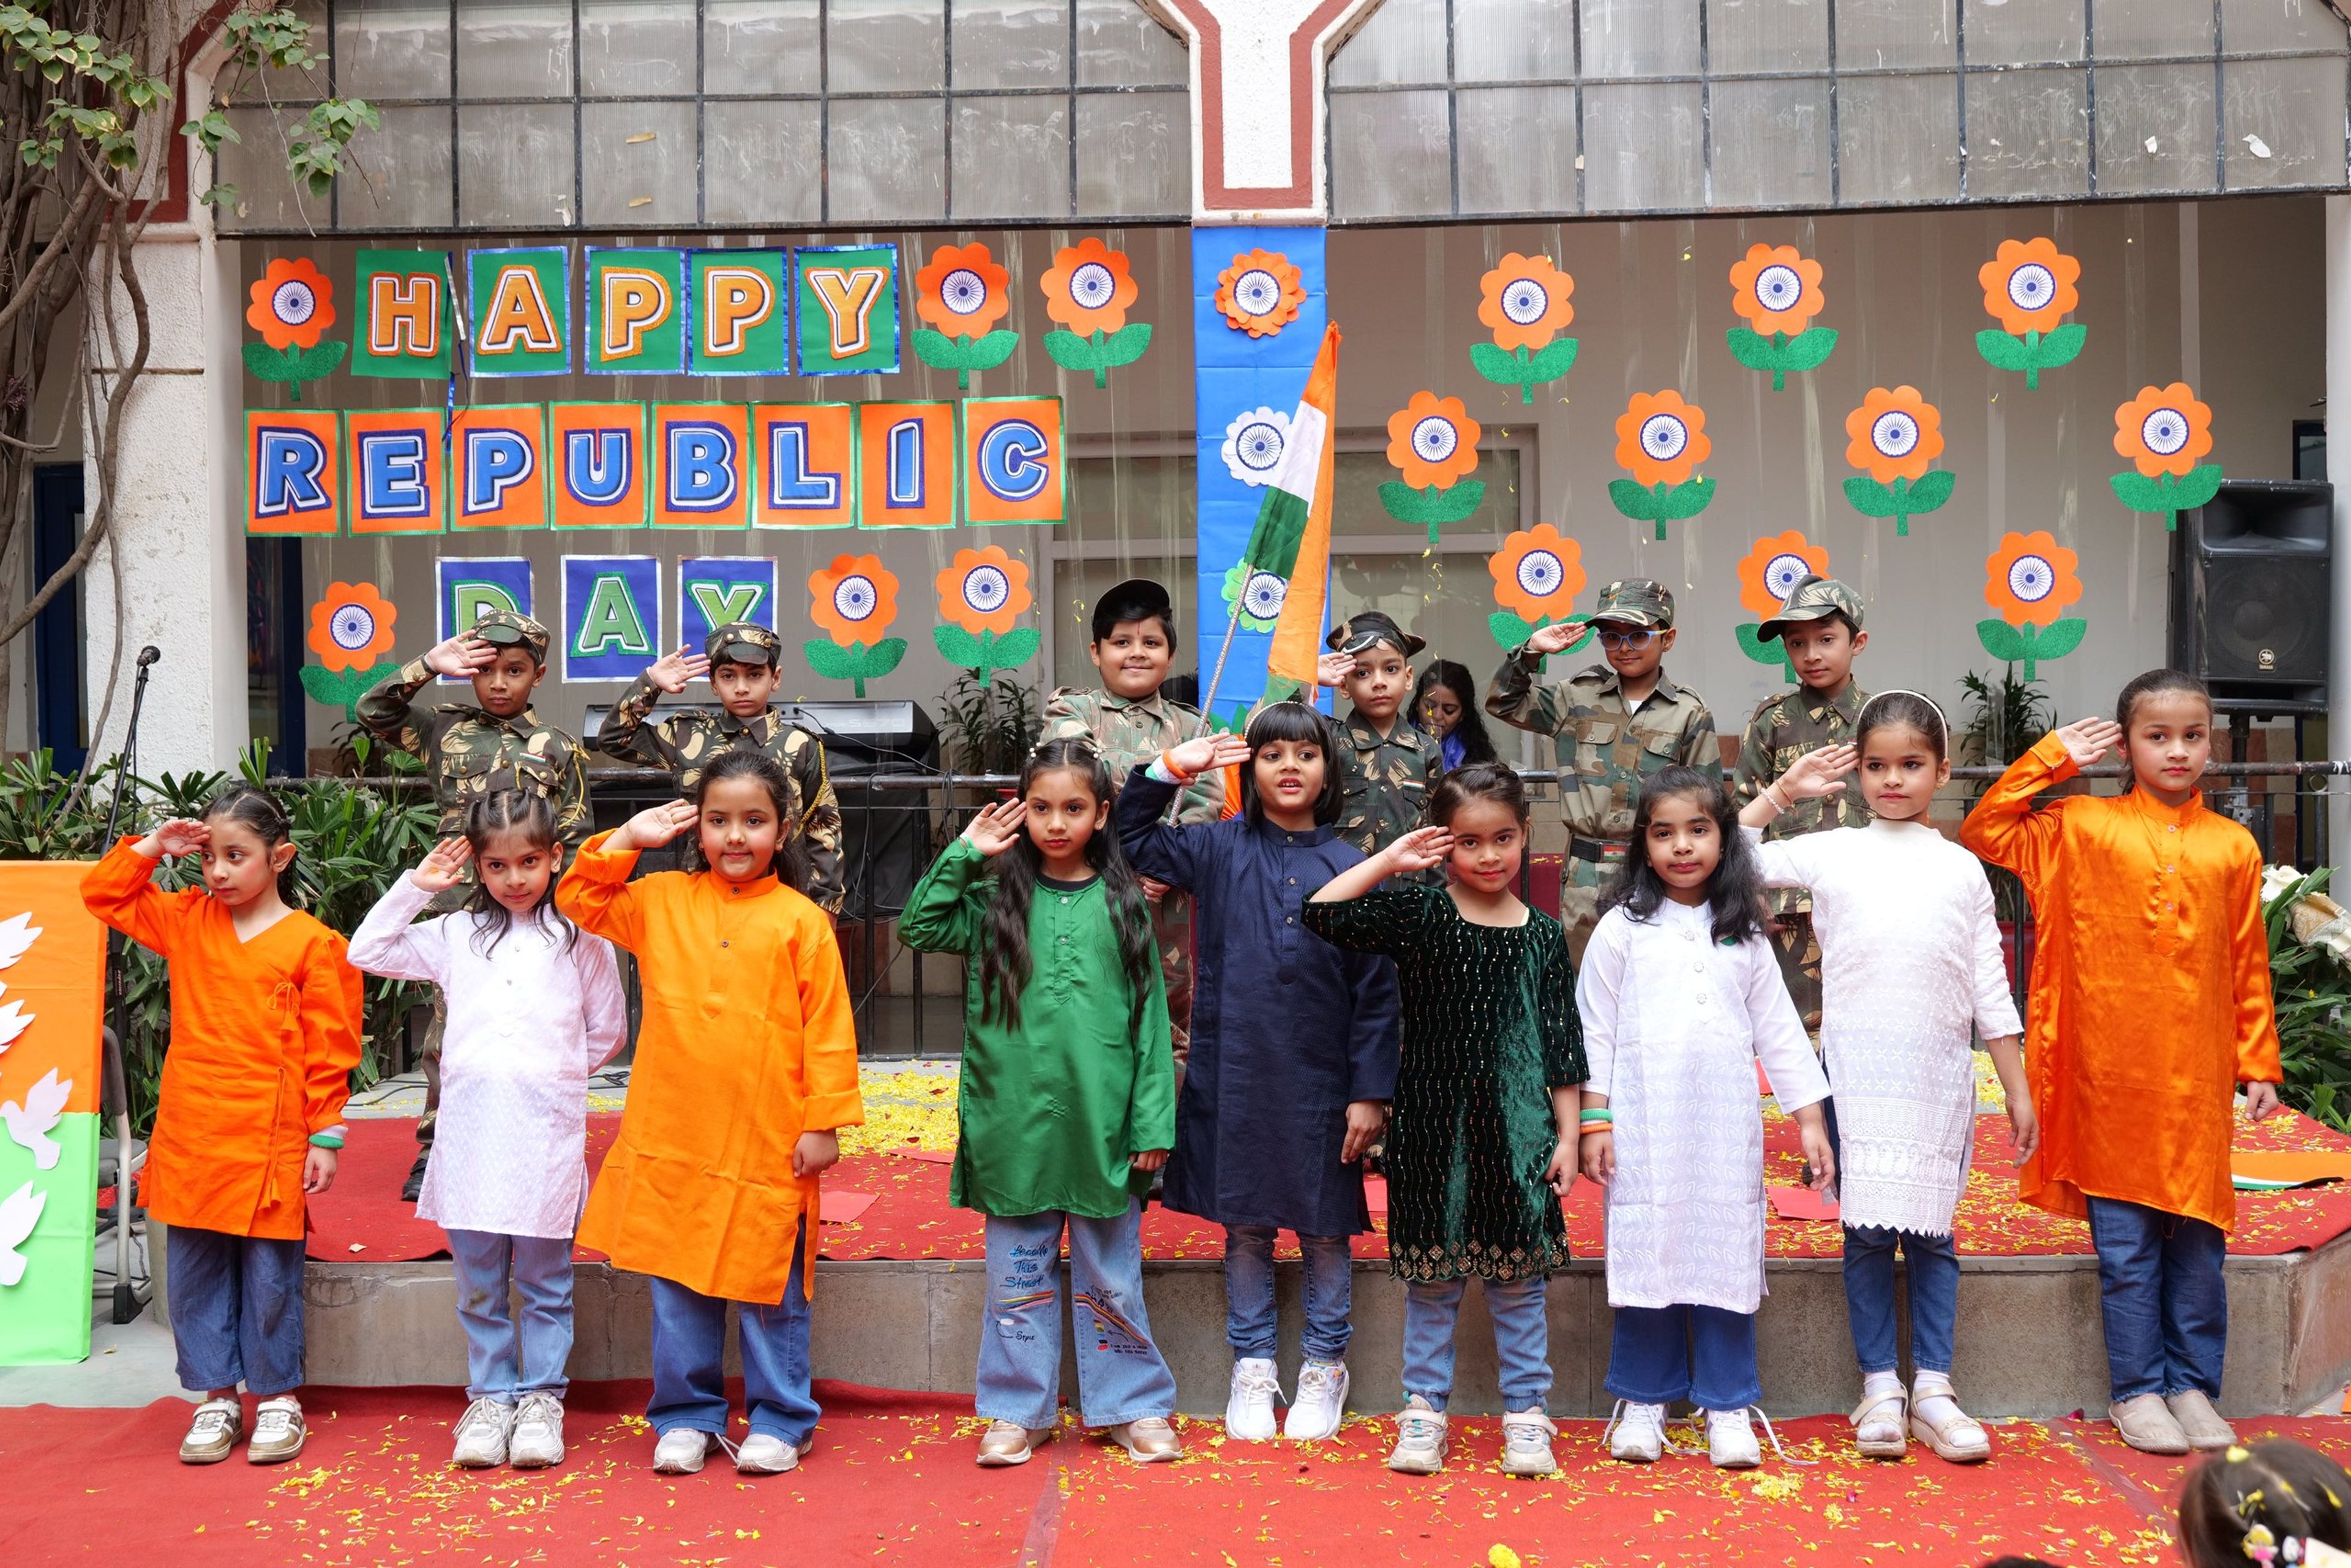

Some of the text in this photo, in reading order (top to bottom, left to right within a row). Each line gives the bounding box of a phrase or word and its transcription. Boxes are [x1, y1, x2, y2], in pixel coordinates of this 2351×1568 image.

[367, 265, 890, 362] HAPPY
[255, 418, 1049, 519] REPUBLIC
[1014, 1258, 1038, 1274] This
